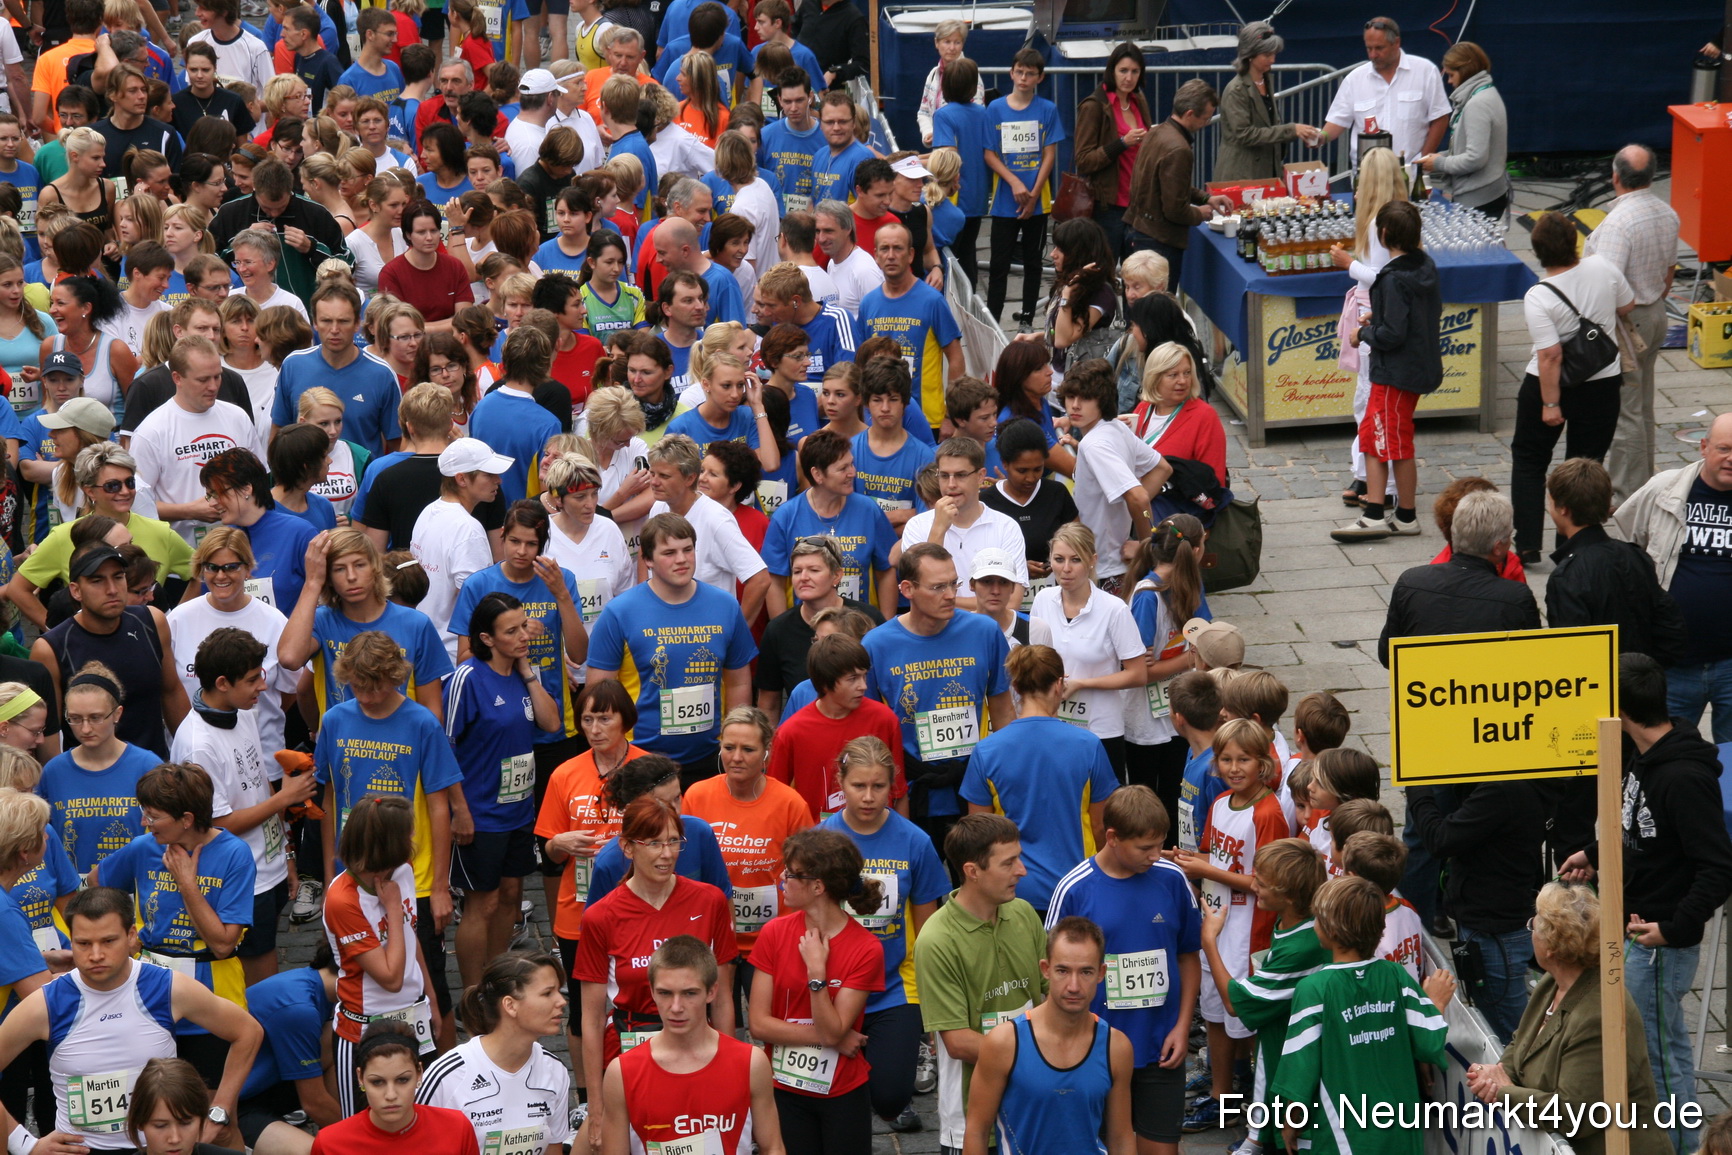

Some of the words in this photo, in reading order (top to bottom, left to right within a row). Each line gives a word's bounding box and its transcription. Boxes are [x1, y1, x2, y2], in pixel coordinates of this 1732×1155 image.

[1012, 132, 1037, 142] 4055
[779, 158, 812, 167] STADTLAU
[781, 152, 814, 161] NEUMARK
[595, 321, 632, 331] BOCK
[873, 324, 911, 332] STADTLAUF
[874, 317, 921, 326] NEUMARKTER
[1267, 320, 1337, 366] Glossn
[1315, 340, 1340, 361] Bi
[1275, 373, 1300, 388] Der
[1303, 371, 1353, 389] hochfeine
[10, 387, 33, 398] 151
[1281, 388, 1345, 404] Biergenuss
[175, 441, 226, 455] GERHART
[201, 449, 223, 461] JAN
[316, 486, 353, 495] JANIG
[759, 496, 783, 507] 242
[642, 628, 656, 637] 10.
[658, 625, 723, 636] NEUMARKTER
[657, 634, 712, 645] STADTLAUF
[890, 666, 904, 676] 10.
[905, 657, 976, 673] NEUMARKTER
[904, 667, 963, 682] STADTLAUF
[1406, 676, 1600, 708] Schnupper-
[678, 702, 711, 719] 5250
[932, 709, 970, 724] Bernhard
[920, 730, 925, 738] S
[936, 725, 974, 742] 5017
[1473, 713, 1535, 744] lauf
[336, 739, 346, 748] 10.
[347, 739, 413, 755] NEUMARKTER
[344, 748, 397, 762] STADTLAUF
[513, 759, 528, 769] Hilde
[55, 801, 66, 811] 10.
[65, 807, 129, 819] STADTLAUF
[725, 859, 739, 867] und
[147, 871, 157, 880] 10.
[577, 872, 582, 880] S
[731, 890, 755, 902] Birgit
[734, 904, 773, 918] 5045
[1606, 941, 1622, 963] NR
[1122, 956, 1159, 969] Christian
[1108, 974, 1113, 983] S
[1125, 971, 1165, 990] 5173
[1606, 968, 1622, 986] 69
[107, 1012, 123, 1020] asics
[1341, 1008, 1353, 1023] FC
[1354, 1000, 1396, 1016] Ezelsdorf
[1349, 1026, 1395, 1046] Laufgruppe
[787, 1050, 829, 1075] 5091
[87, 1079, 120, 1092] Martin
[471, 1081, 492, 1091] adidas
[71, 1100, 76, 1109] S
[91, 1092, 133, 1116] 514
[471, 1107, 504, 1121] Pyraser
[474, 1117, 503, 1128] Waldquelle
[674, 1113, 737, 1135] EnBW
[504, 1131, 544, 1146] Katharina
